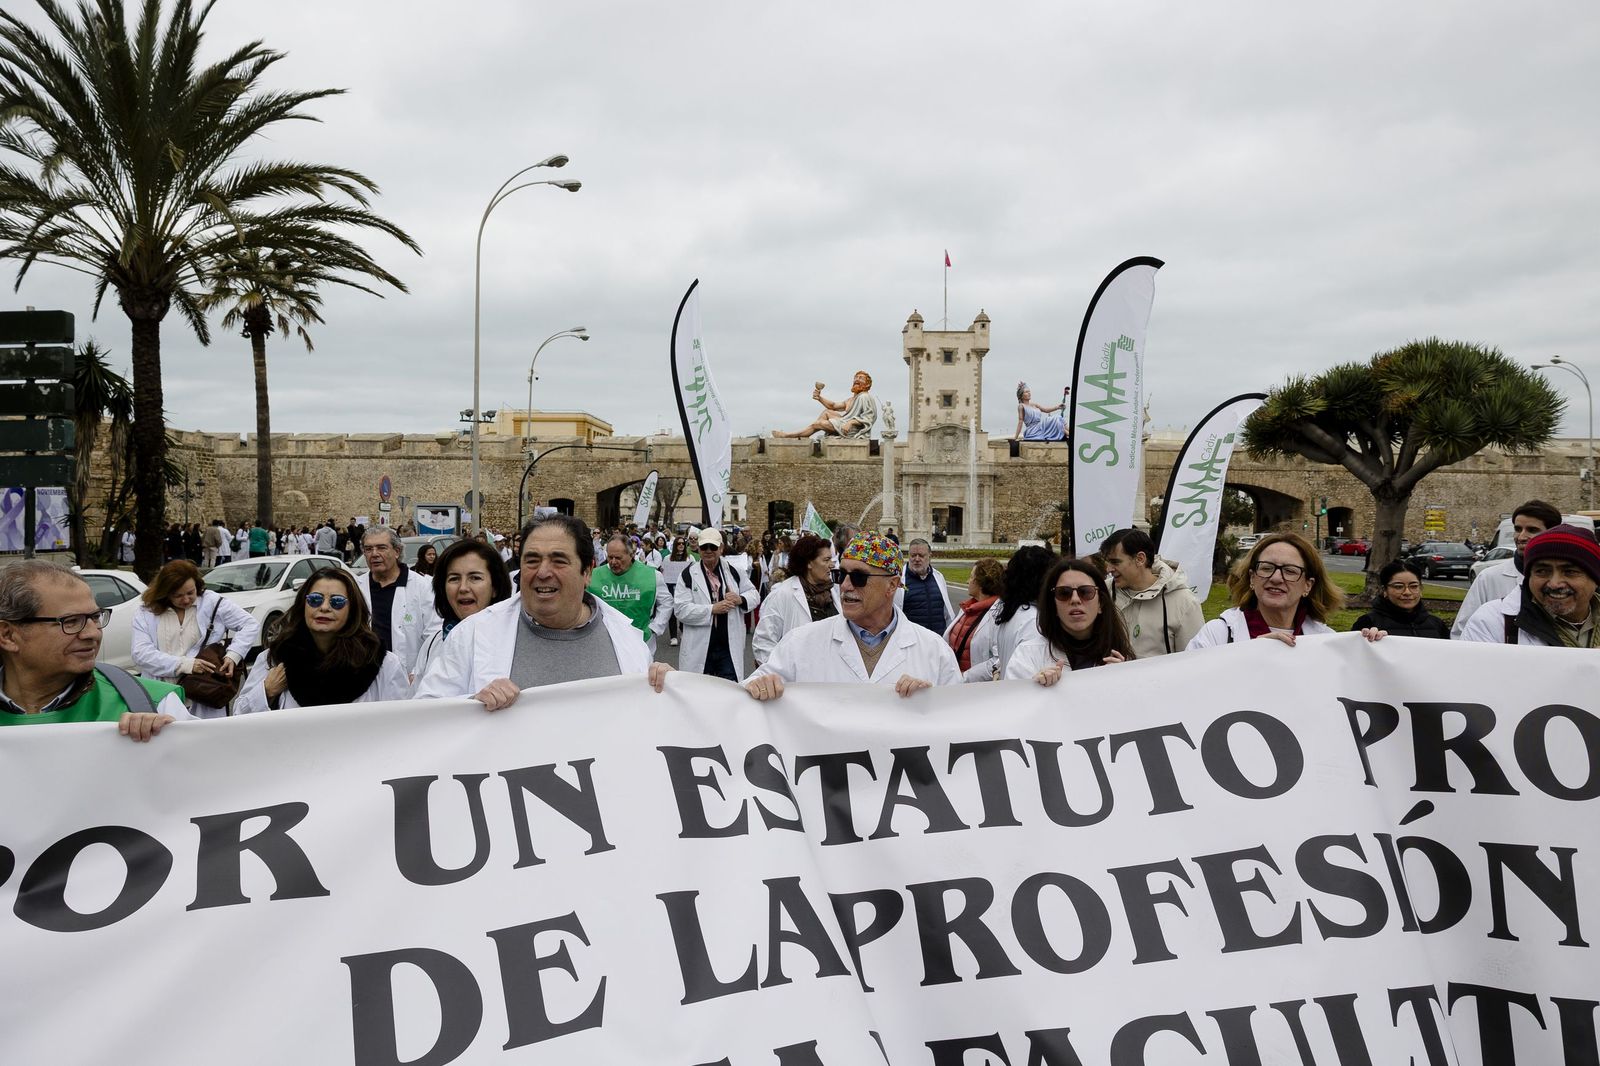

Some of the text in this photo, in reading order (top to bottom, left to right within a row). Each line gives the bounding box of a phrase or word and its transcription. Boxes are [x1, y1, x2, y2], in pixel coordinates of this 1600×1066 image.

[1076, 342, 1128, 466] SMA Cádiz
[1130, 416, 1138, 439] Médico
[1171, 433, 1226, 528] SMA Cádiz
[1085, 524, 1116, 543] CÁDIZ
[602, 583, 631, 599] SMA
[382, 758, 616, 886] UN
[656, 710, 1304, 846] ESTATUTO
[340, 800, 1590, 1066] DE LA PROFESIÓN
